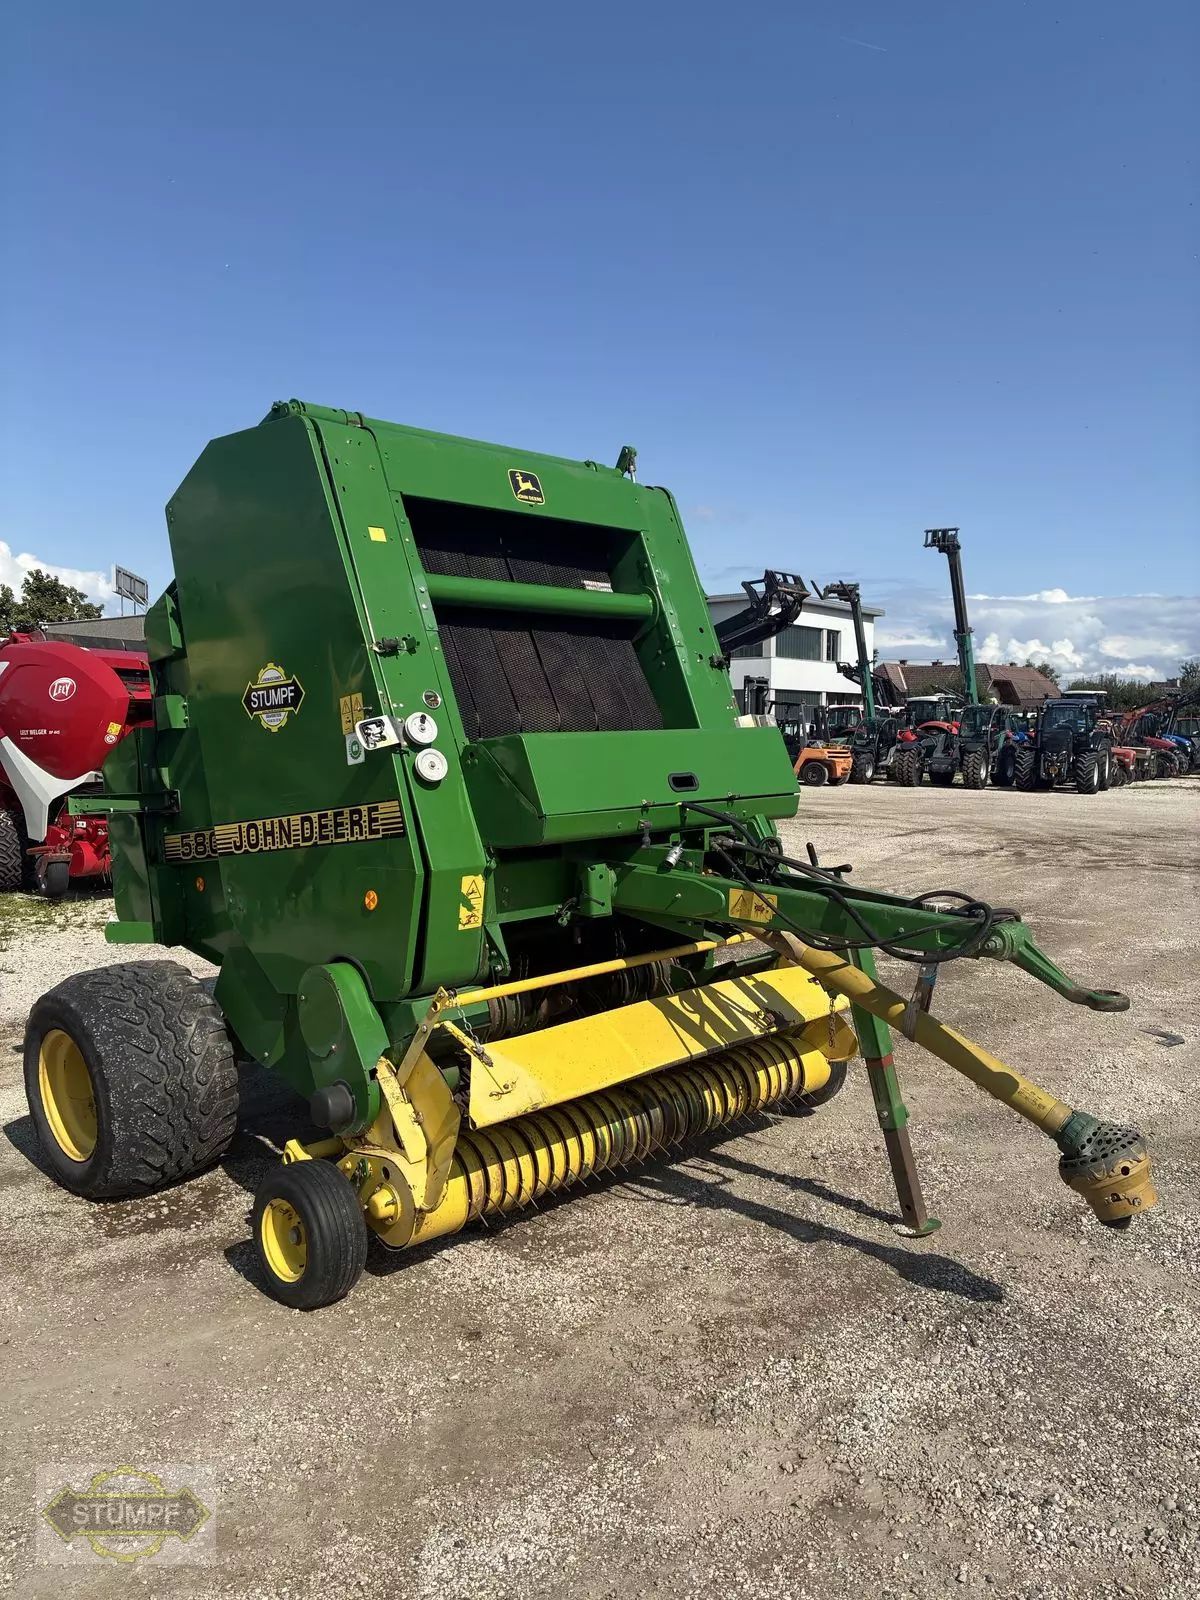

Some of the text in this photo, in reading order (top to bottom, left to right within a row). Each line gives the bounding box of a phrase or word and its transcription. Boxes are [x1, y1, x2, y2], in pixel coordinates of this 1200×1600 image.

[53, 682, 72, 697] LELY
[250, 686, 295, 708] STUMPF
[232, 805, 382, 854] JOHN DEERE
